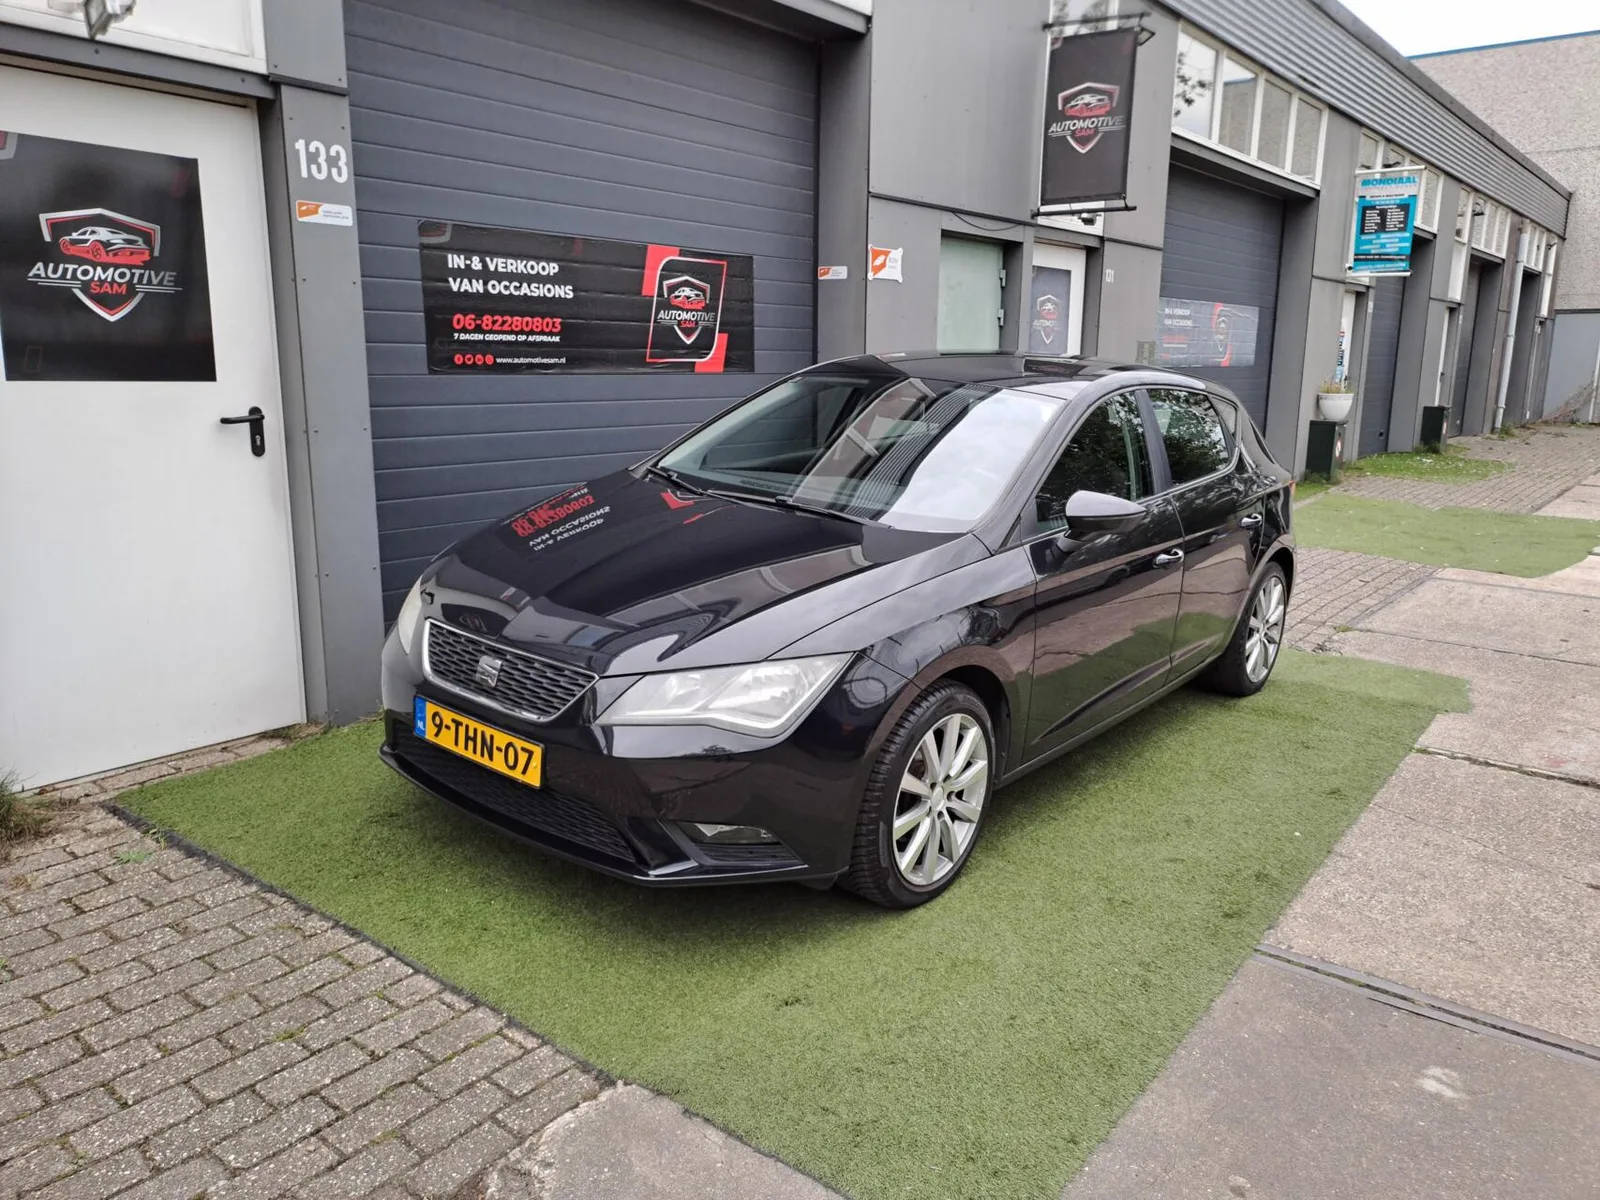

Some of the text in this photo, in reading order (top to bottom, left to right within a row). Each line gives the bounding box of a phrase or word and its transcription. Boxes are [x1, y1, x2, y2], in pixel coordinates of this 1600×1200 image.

[1049, 116, 1125, 133] AUTOMOTIVE
[1074, 129, 1095, 138] SAM
[295, 139, 348, 184] 133
[1362, 176, 1417, 187] MONDIAAL
[28, 262, 177, 286] AUTOMOTIVE
[486, 257, 559, 276] VERKOOP
[90, 282, 126, 294] SAM
[448, 277, 574, 299] VAN OCCASIONS
[452, 313, 562, 333] 06-82280803
[657, 310, 715, 321] AUTOMOTIVE
[459, 333, 484, 341] DAGEN
[485, 334, 516, 342] GEOPEND
[527, 335, 561, 343] AFSPRAAK
[417, 719, 426, 731] NL
[431, 710, 534, 776] 9-THN-07
